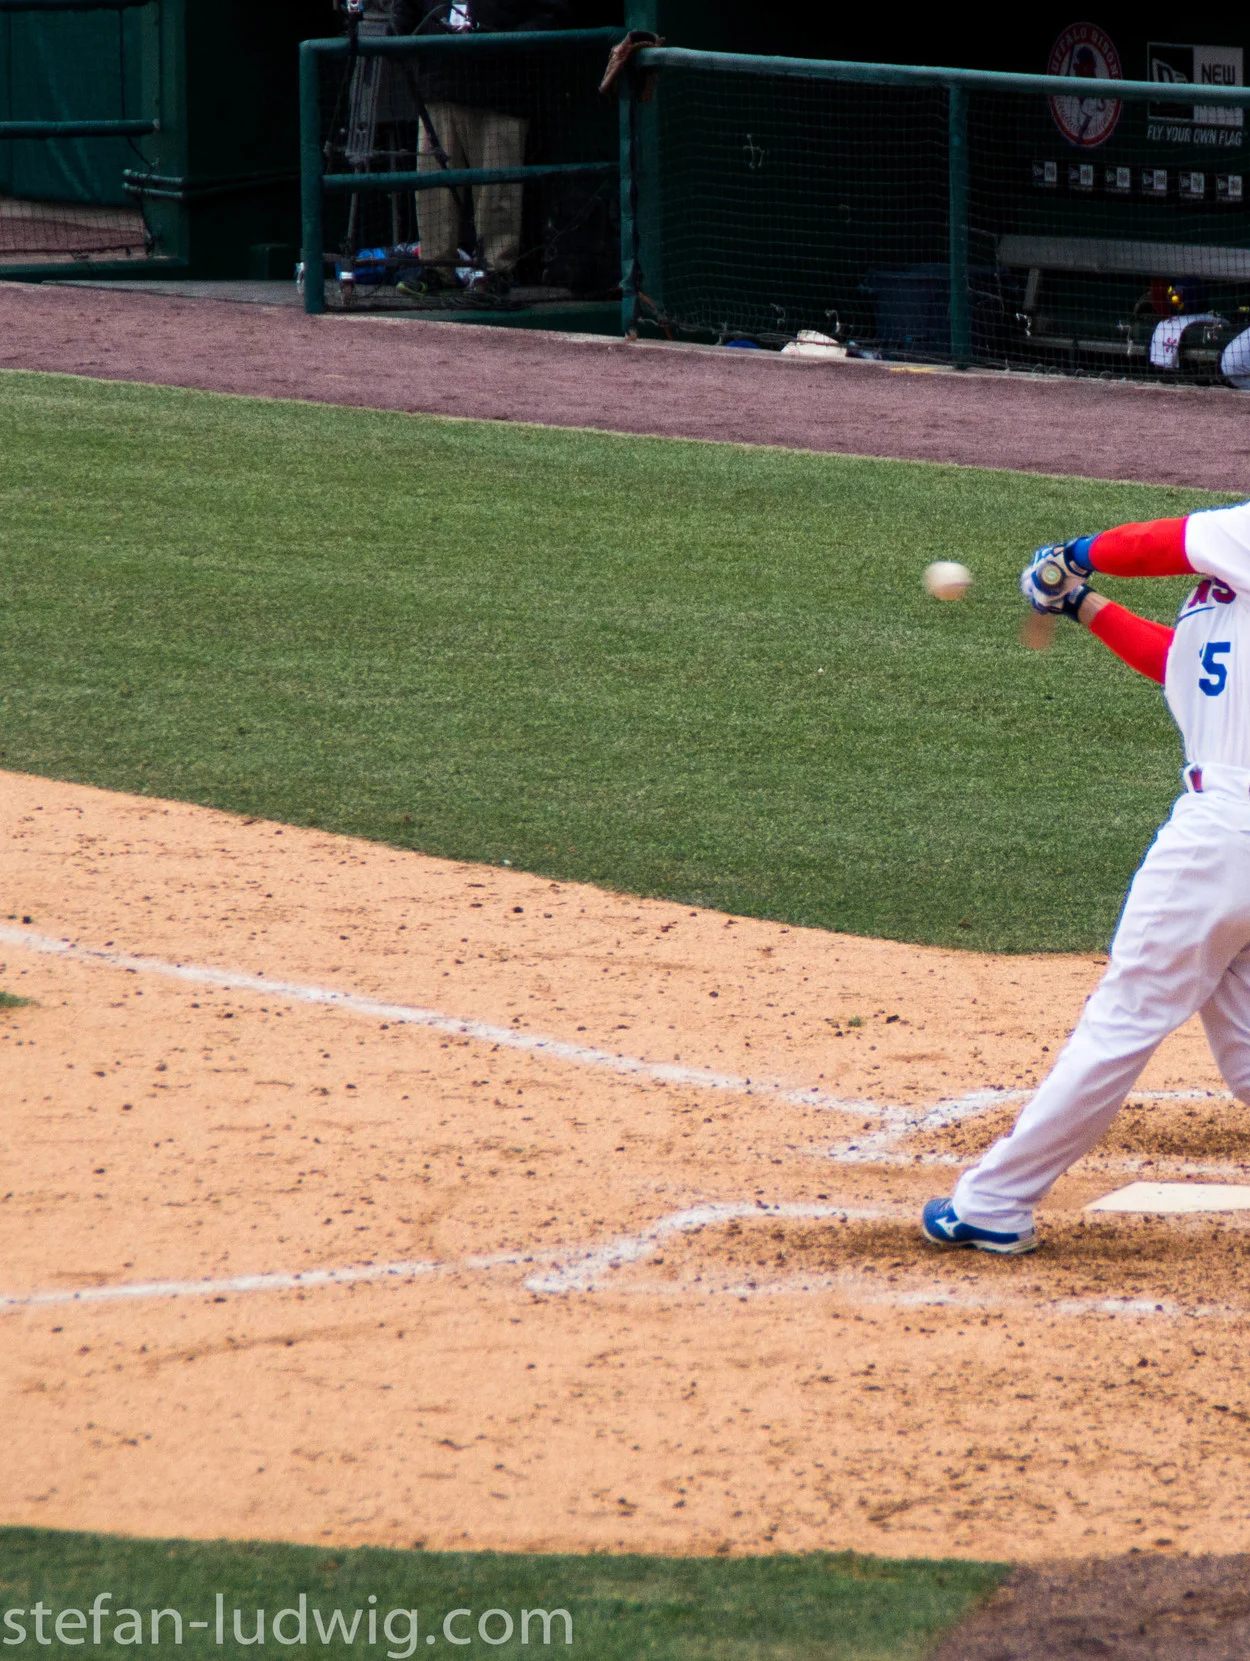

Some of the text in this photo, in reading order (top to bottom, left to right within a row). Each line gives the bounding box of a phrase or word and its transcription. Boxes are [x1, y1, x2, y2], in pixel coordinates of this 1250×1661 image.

[1051, 27, 1118, 78] UFFALO BISON
[1201, 63, 1235, 84] NEW
[1147, 124, 1243, 147] FLY YOUR OWN FLAG
